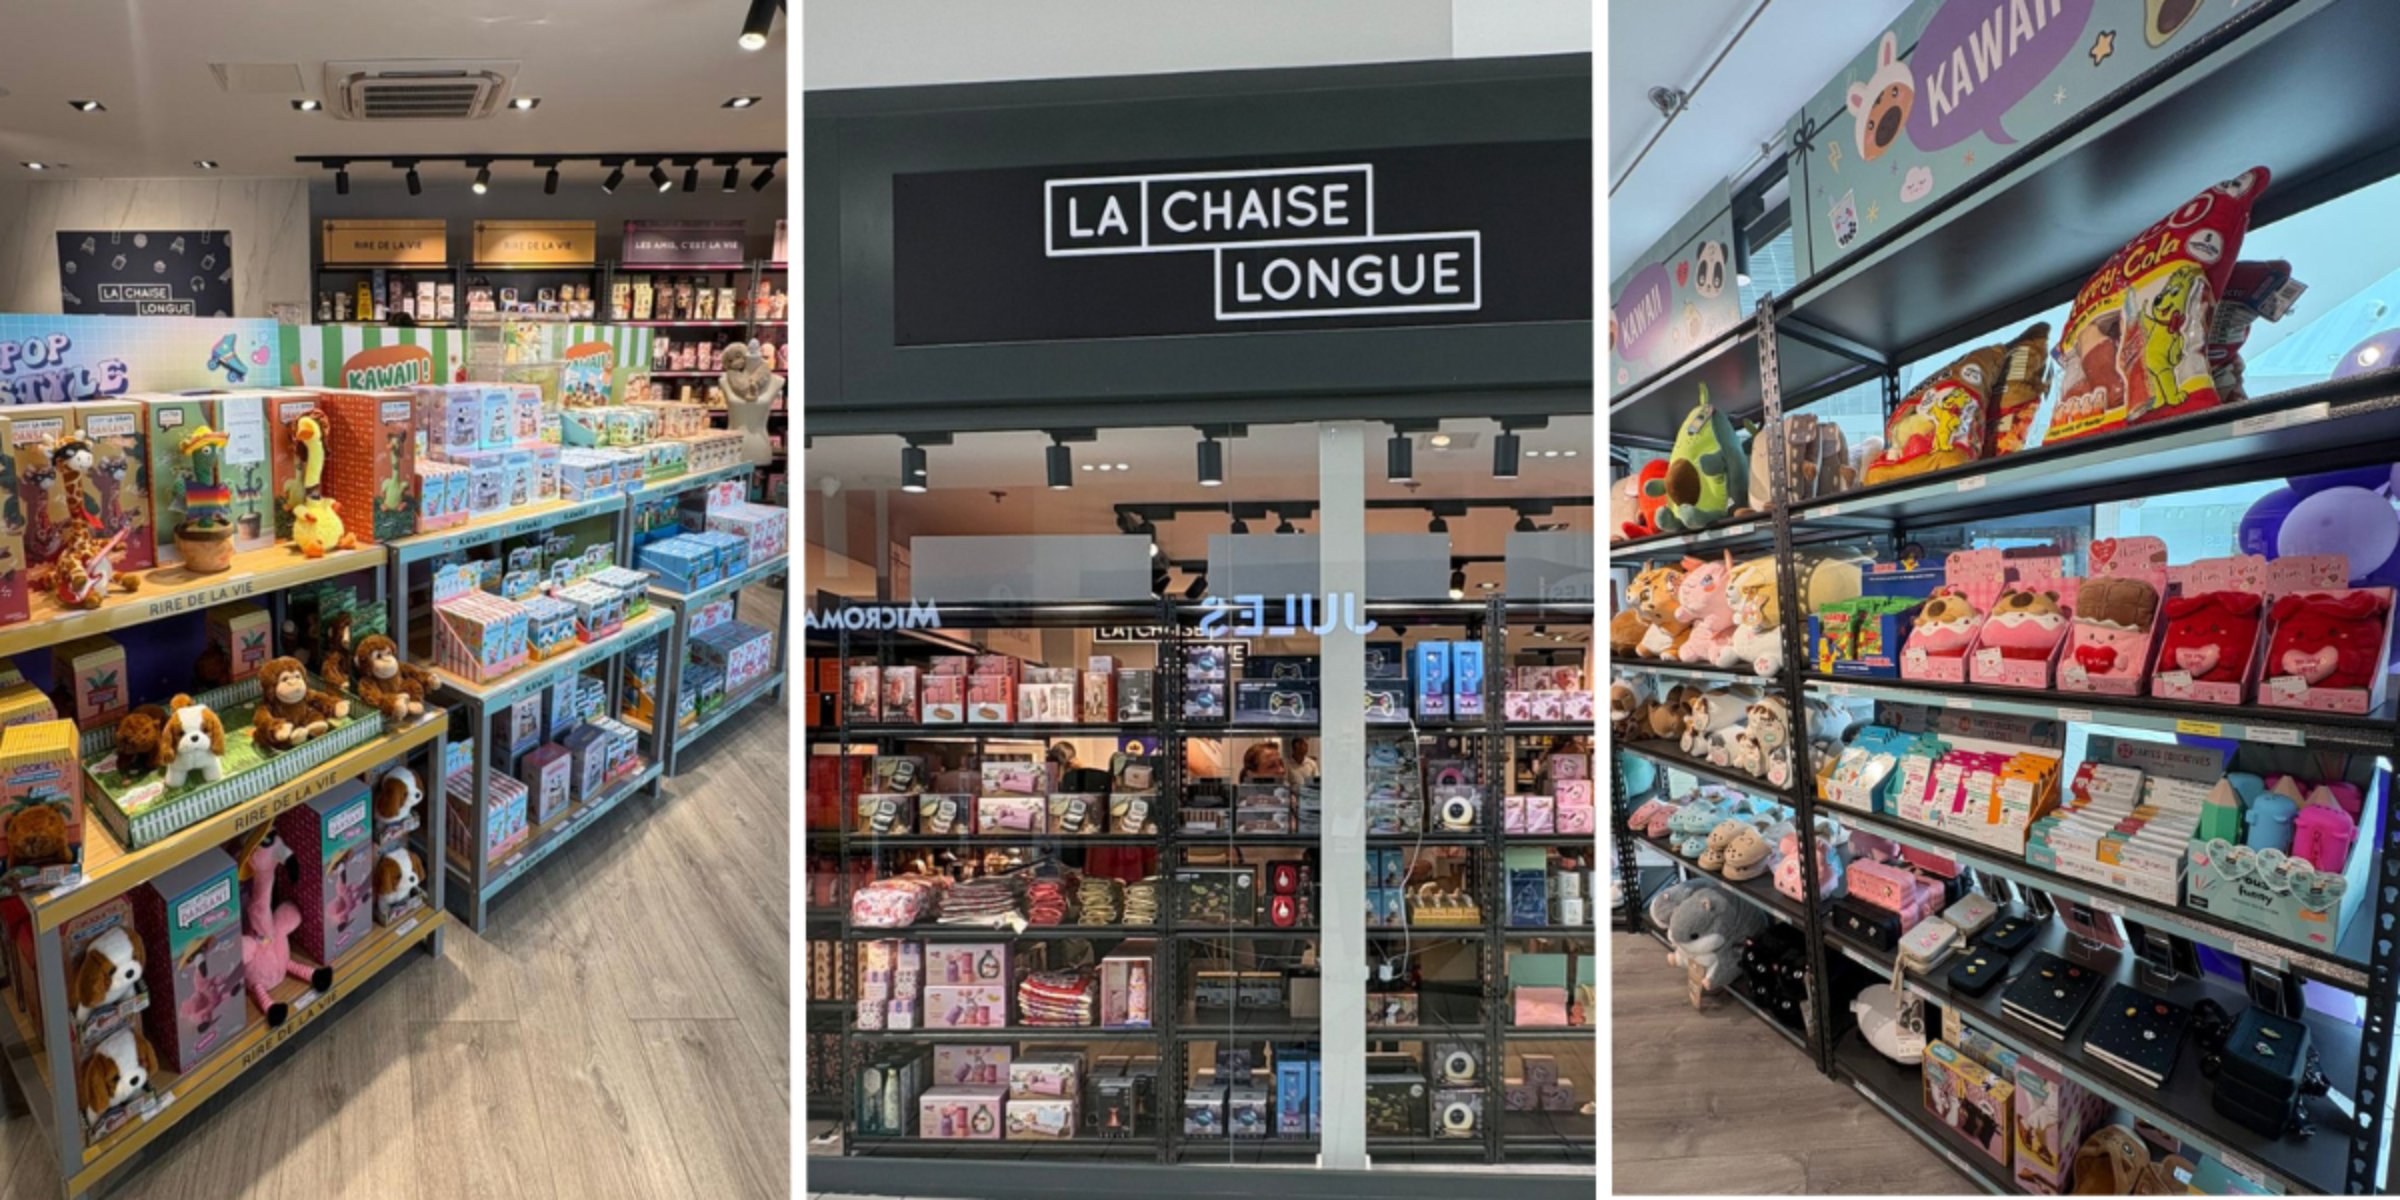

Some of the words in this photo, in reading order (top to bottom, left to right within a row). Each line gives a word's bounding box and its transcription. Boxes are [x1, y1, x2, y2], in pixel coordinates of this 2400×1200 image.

[1069, 195, 1129, 238] LA
[1161, 183, 1350, 233] CHAISE
[377, 240, 390, 250] DE
[392, 240, 405, 250] LA
[708, 241, 721, 250] LA
[723, 241, 738, 250] VIE
[103, 288, 119, 298] LA
[124, 287, 167, 299] CHAISE
[1236, 251, 1461, 303] LONGUE
[141, 303, 191, 315] LONGUE
[1621, 283, 1663, 350] KAWAII
[0, 332, 72, 374] POP
[0, 358, 129, 404] STYLE
[346, 358, 420, 390] KAWAII
[148, 597, 183, 616] RIRE
[187, 591, 206, 607] DE
[210, 588, 229, 602] LA
[231, 581, 254, 597] VIE
[235, 805, 268, 832] RIRE
[273, 793, 292, 812] DE
[295, 784, 312, 802] LA
[316, 771, 337, 790] VIE
[2239, 884, 2273, 907] funny
